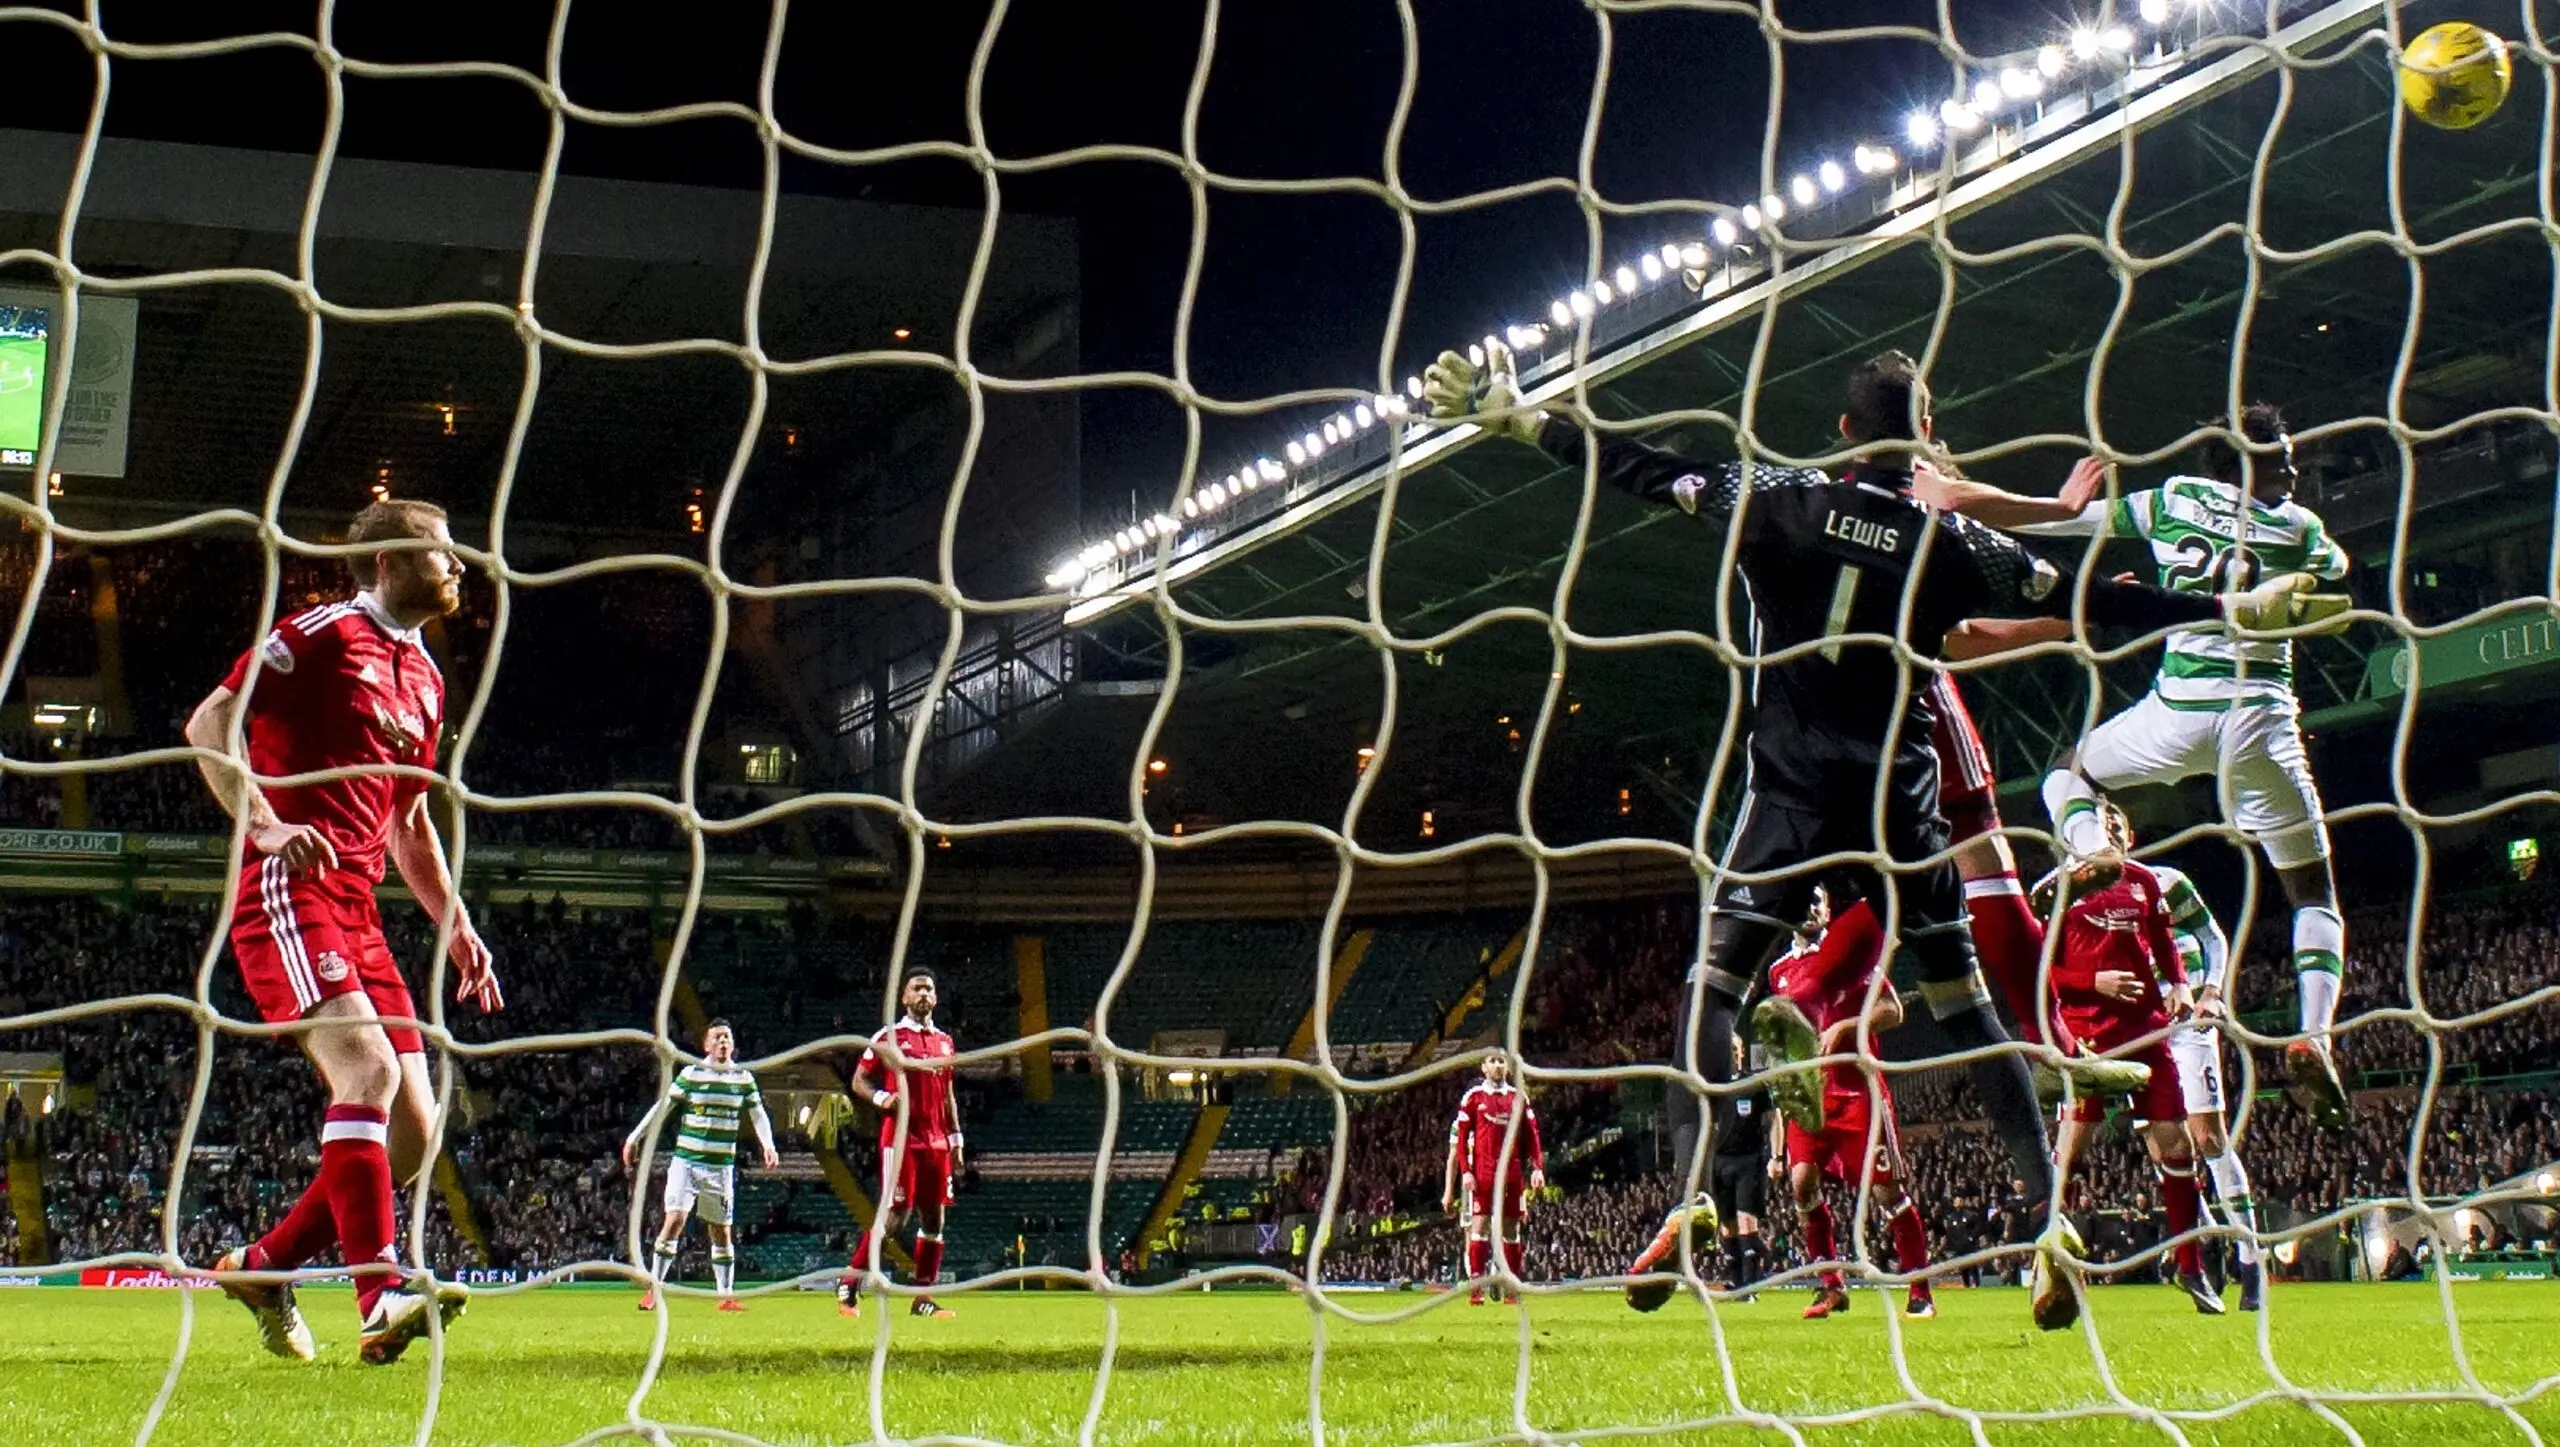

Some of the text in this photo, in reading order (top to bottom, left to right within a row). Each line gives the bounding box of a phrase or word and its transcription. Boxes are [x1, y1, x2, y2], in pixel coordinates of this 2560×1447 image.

[1824, 509, 1899, 551] LEWIS
[2193, 504, 2257, 540] BOYAA
[1820, 564, 1861, 666] 1
[2203, 1066, 2217, 1092] 6
